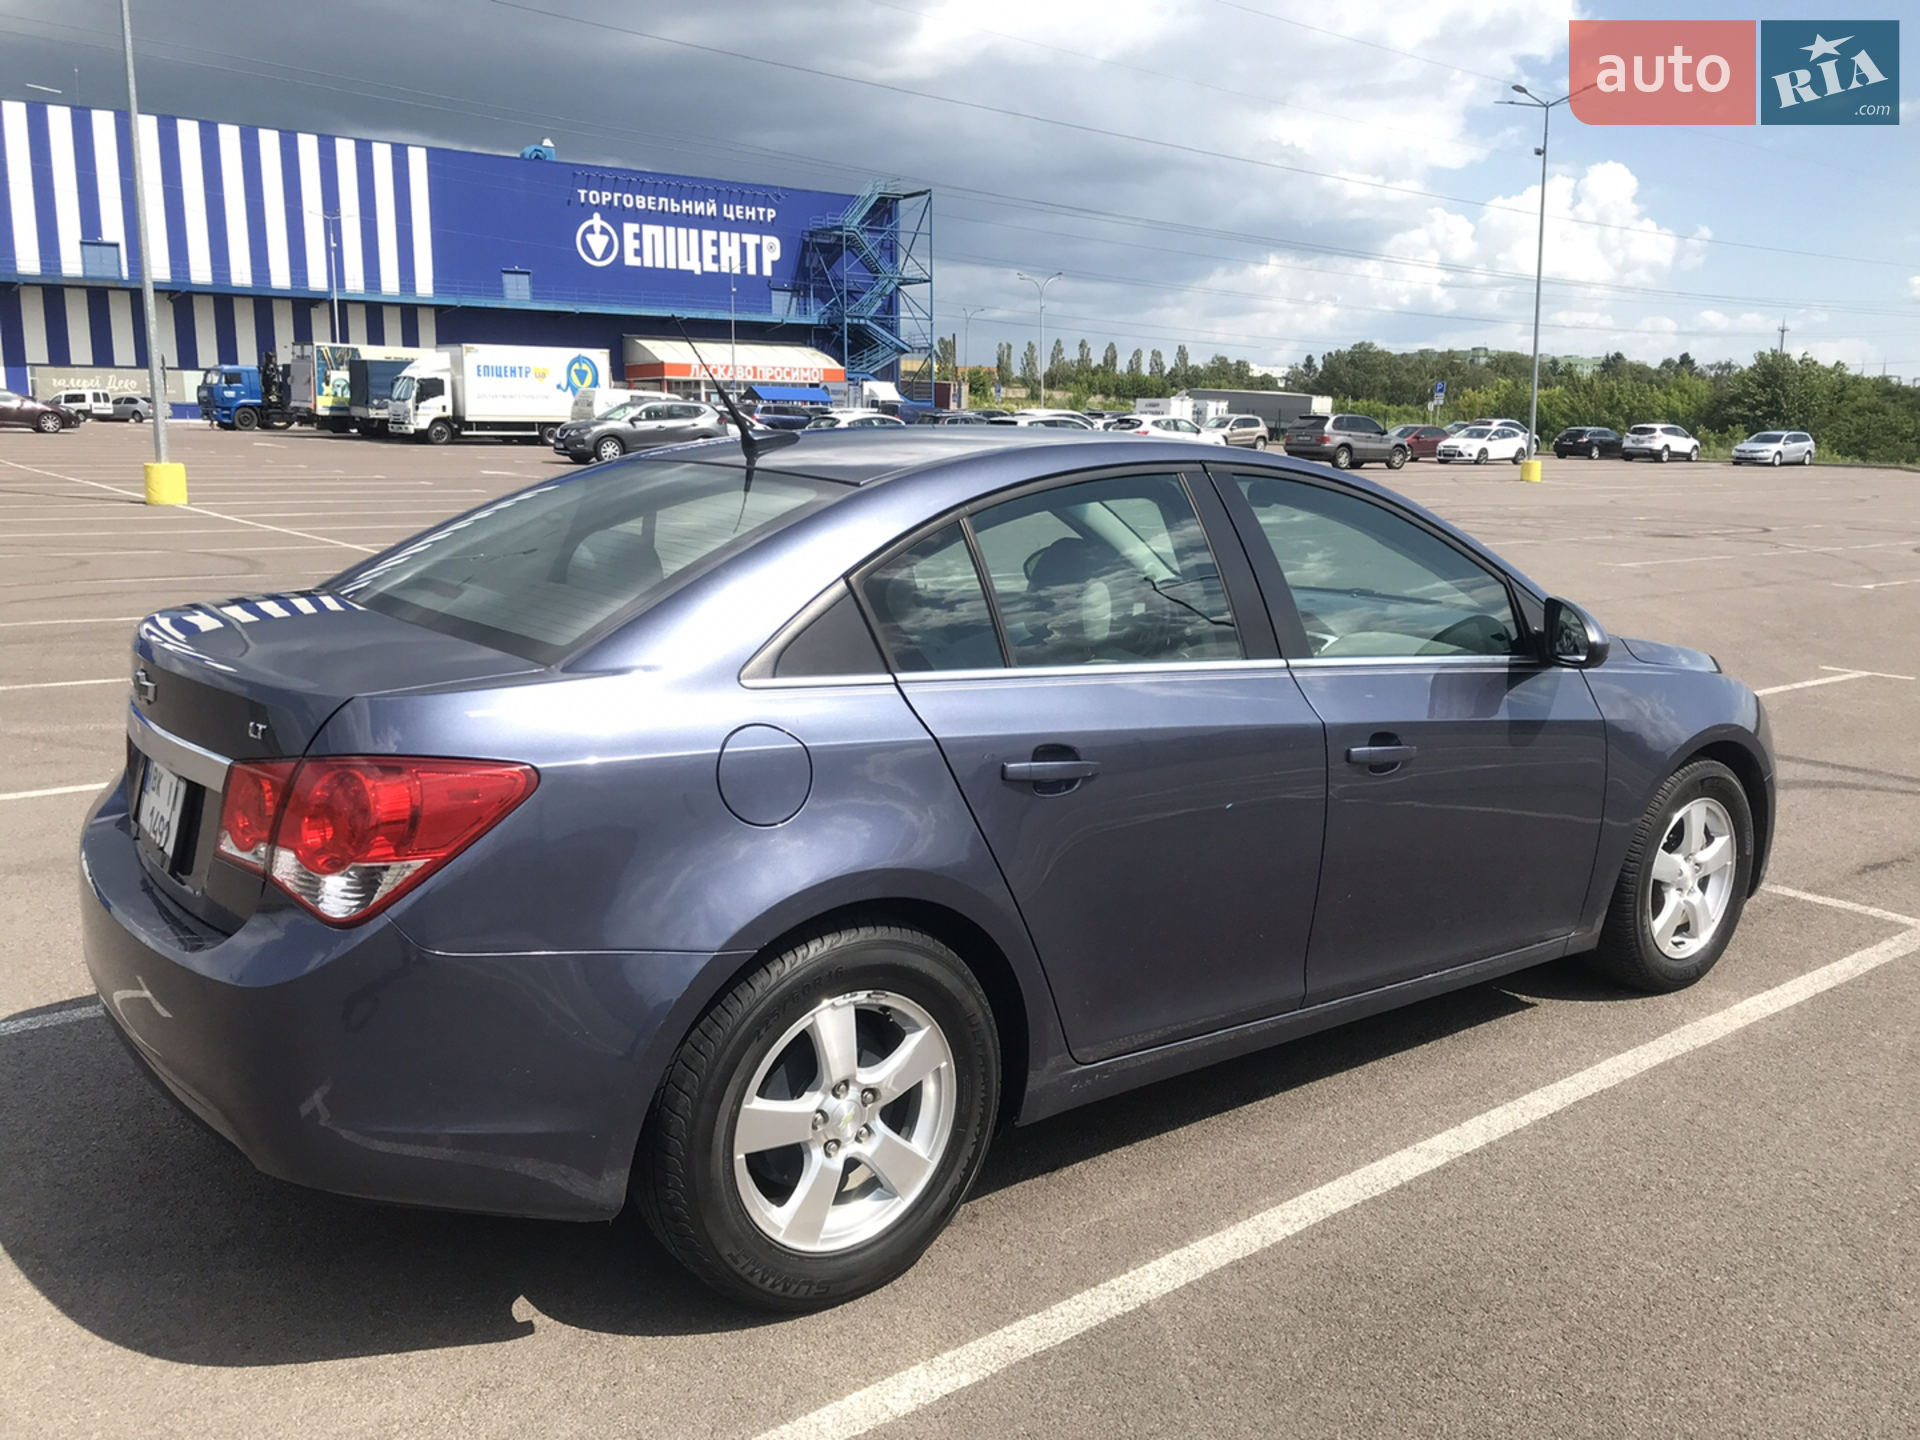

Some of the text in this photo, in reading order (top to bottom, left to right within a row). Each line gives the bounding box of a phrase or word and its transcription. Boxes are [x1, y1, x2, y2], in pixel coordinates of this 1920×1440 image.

[577, 188, 778, 223] ТОРГОВЕЛЬНИЙ ЦЕНТР
[622, 222, 782, 277] ЕПІЦЕНТР
[689, 364, 825, 381] ЛАСКАВО ПРОСИМО!
[249, 721, 268, 740] LT
